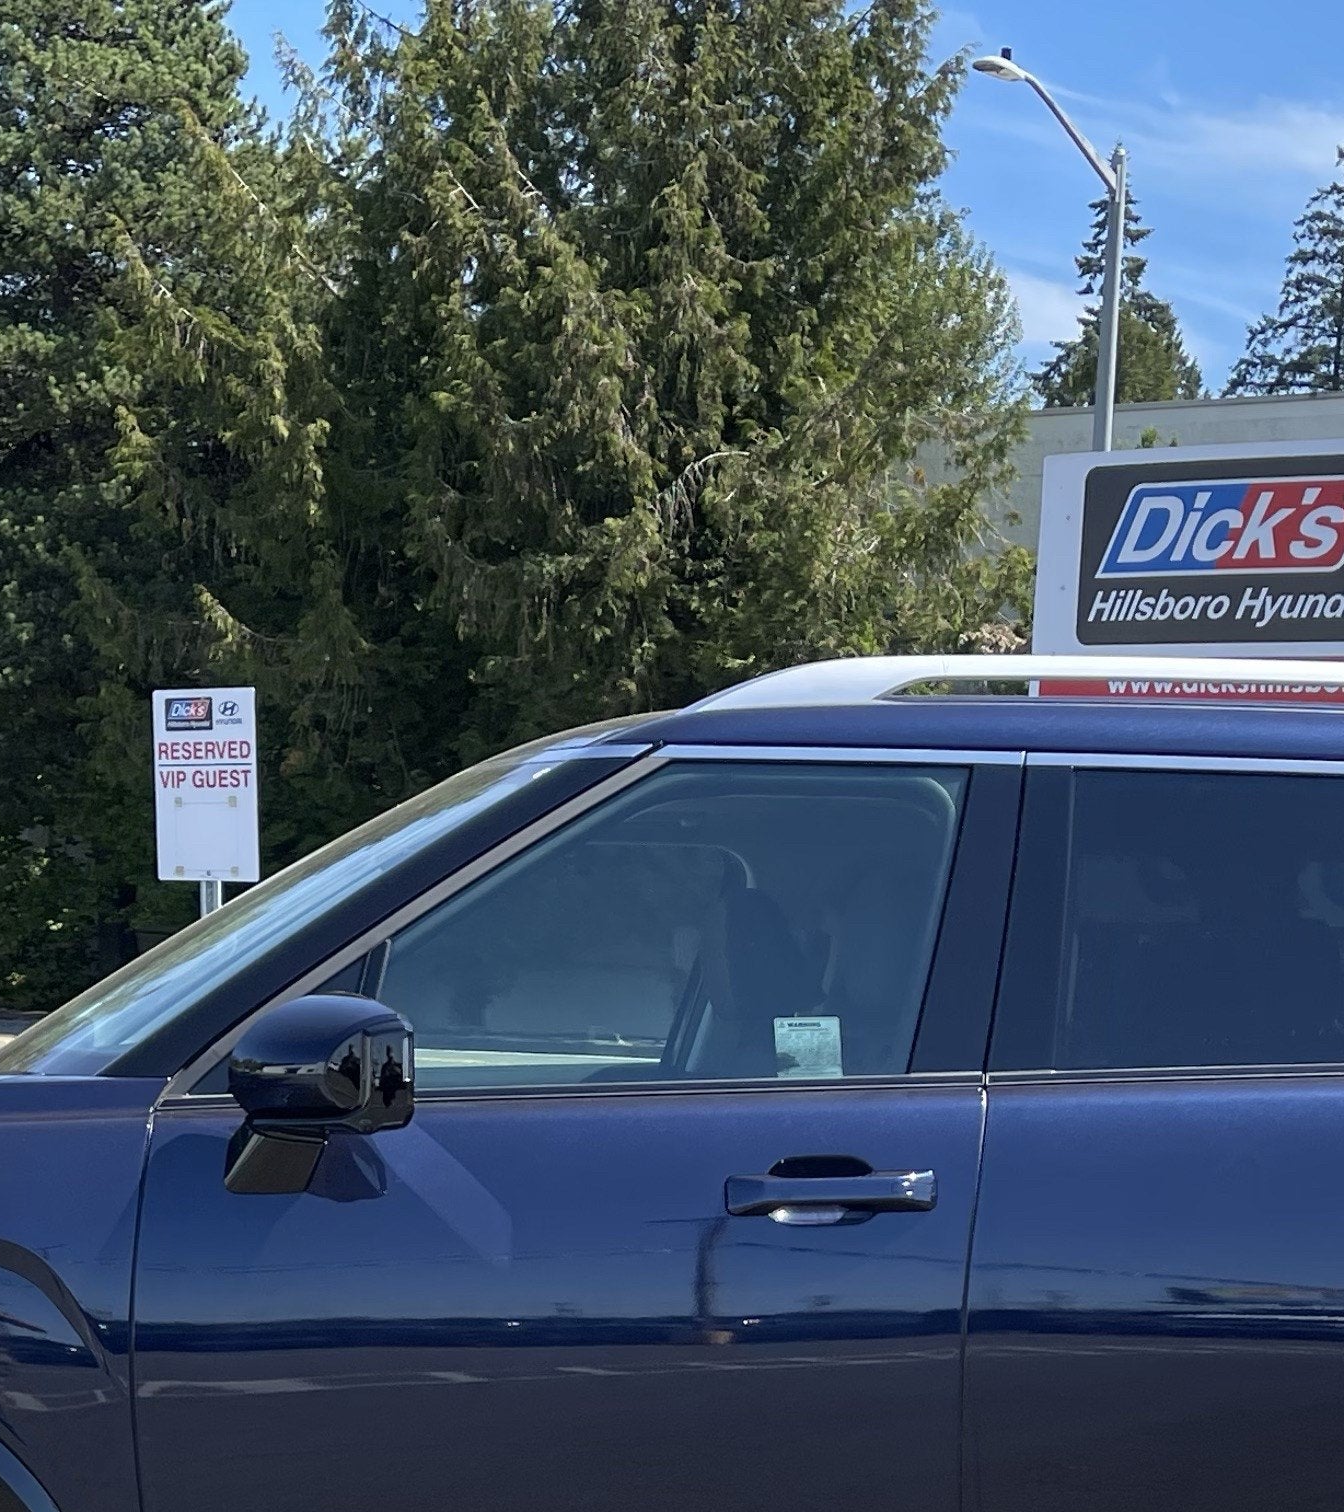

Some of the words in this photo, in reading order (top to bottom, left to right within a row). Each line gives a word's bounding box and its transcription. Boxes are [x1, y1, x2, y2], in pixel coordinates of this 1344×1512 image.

[1087, 588, 1230, 623] Hillsboro
[158, 740, 251, 760] RESERVED
[159, 770, 187, 789] VIP
[191, 769, 252, 789] GUEST
